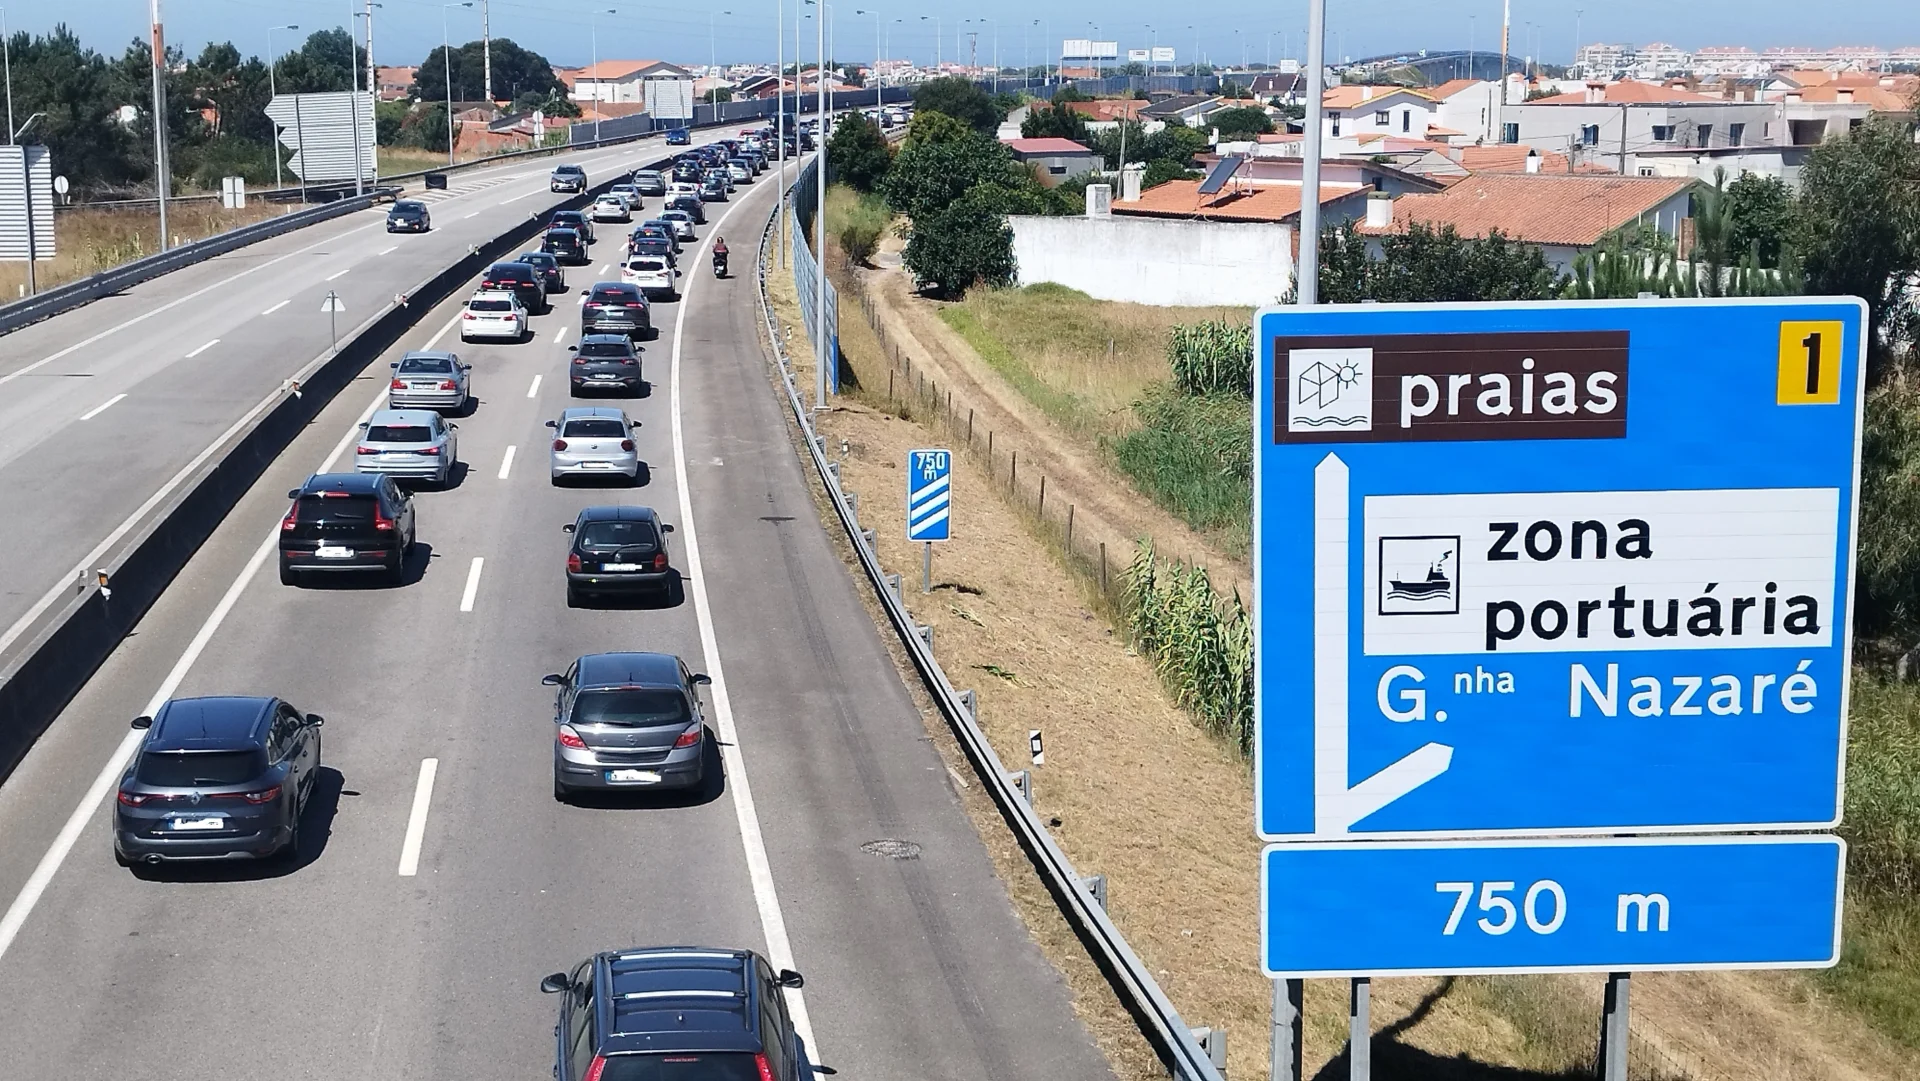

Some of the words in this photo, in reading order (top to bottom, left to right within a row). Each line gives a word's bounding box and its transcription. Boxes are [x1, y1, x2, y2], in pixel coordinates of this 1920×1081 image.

[1802, 332, 1821, 395] 1
[1400, 357, 1618, 428] praias
[917, 453, 945, 474] 750
[924, 470, 937, 481] m
[1487, 518, 1653, 562] zona
[1485, 581, 1821, 651] portuária
[1570, 659, 1817, 718] Nazaré
[1435, 879, 1567, 935] 750
[1616, 893, 1670, 932] m
